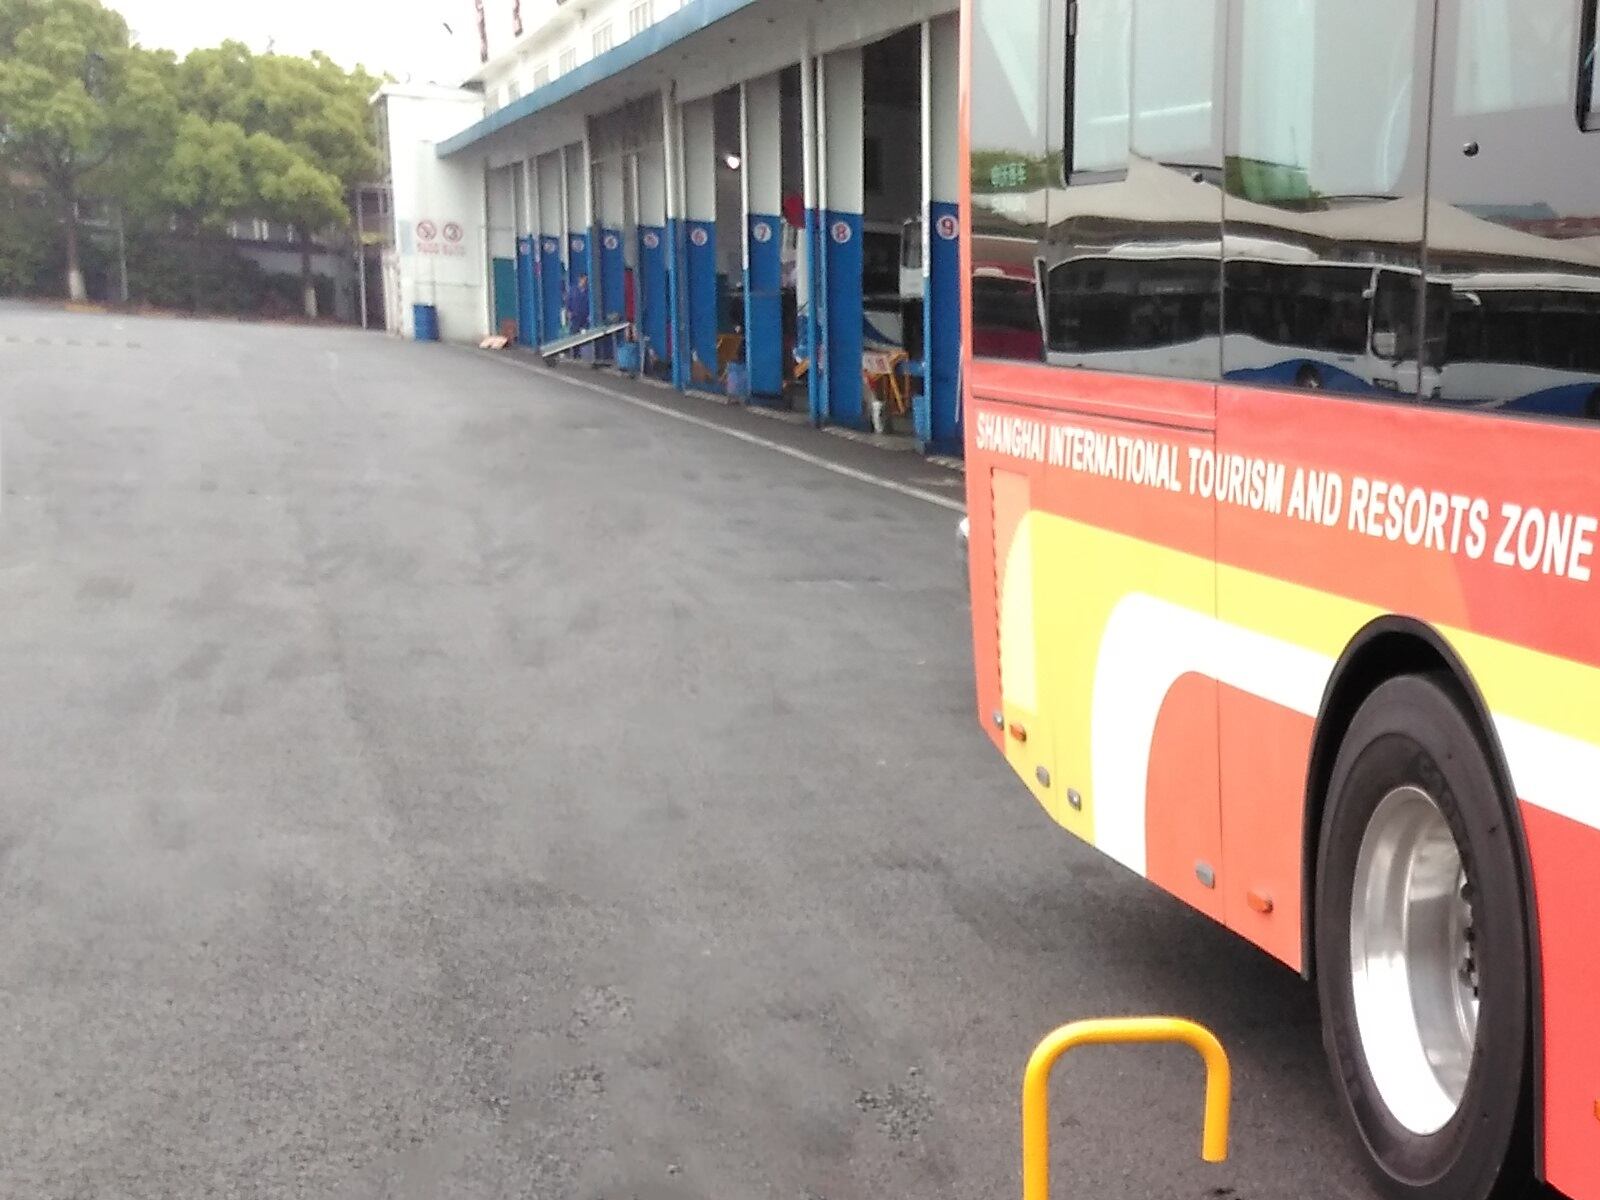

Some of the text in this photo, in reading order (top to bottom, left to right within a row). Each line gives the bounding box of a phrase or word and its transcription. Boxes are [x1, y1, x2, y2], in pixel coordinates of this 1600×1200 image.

[976, 412, 1598, 582] SHANGHAI INTERNATIONAL TOURISM AND RESORTS ZONE
